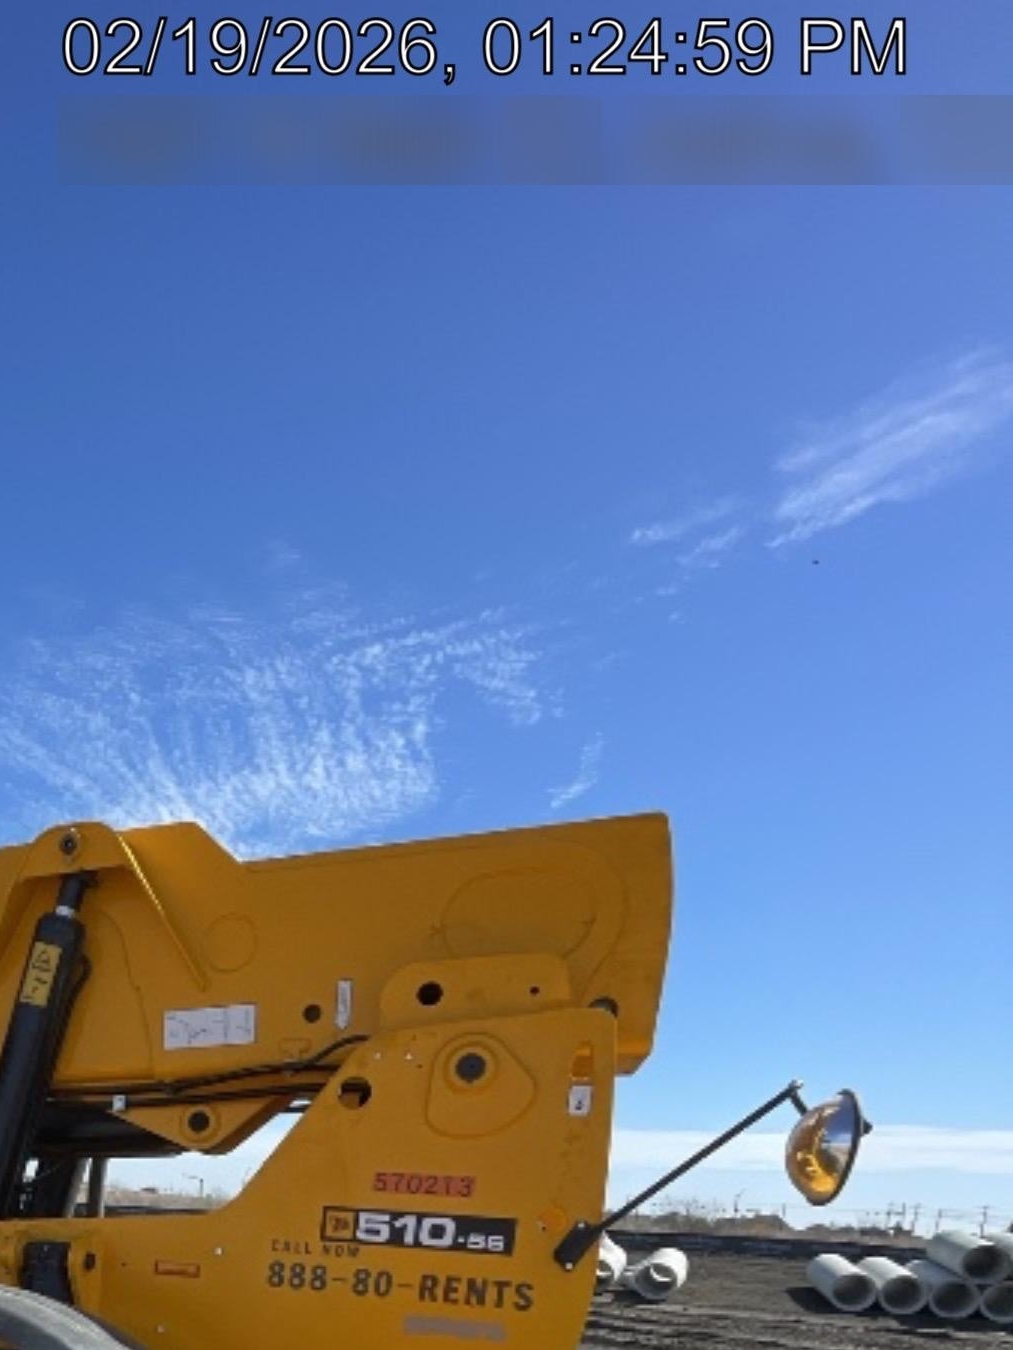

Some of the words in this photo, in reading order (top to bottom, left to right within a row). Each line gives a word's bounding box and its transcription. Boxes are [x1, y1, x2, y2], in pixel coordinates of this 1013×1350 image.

[373, 1172, 475, 1198] 570213
[271, 1239, 312, 1255] CALL
[322, 1243, 360, 1258] NOW
[268, 1260, 535, 1312] 888-80-RENTS
